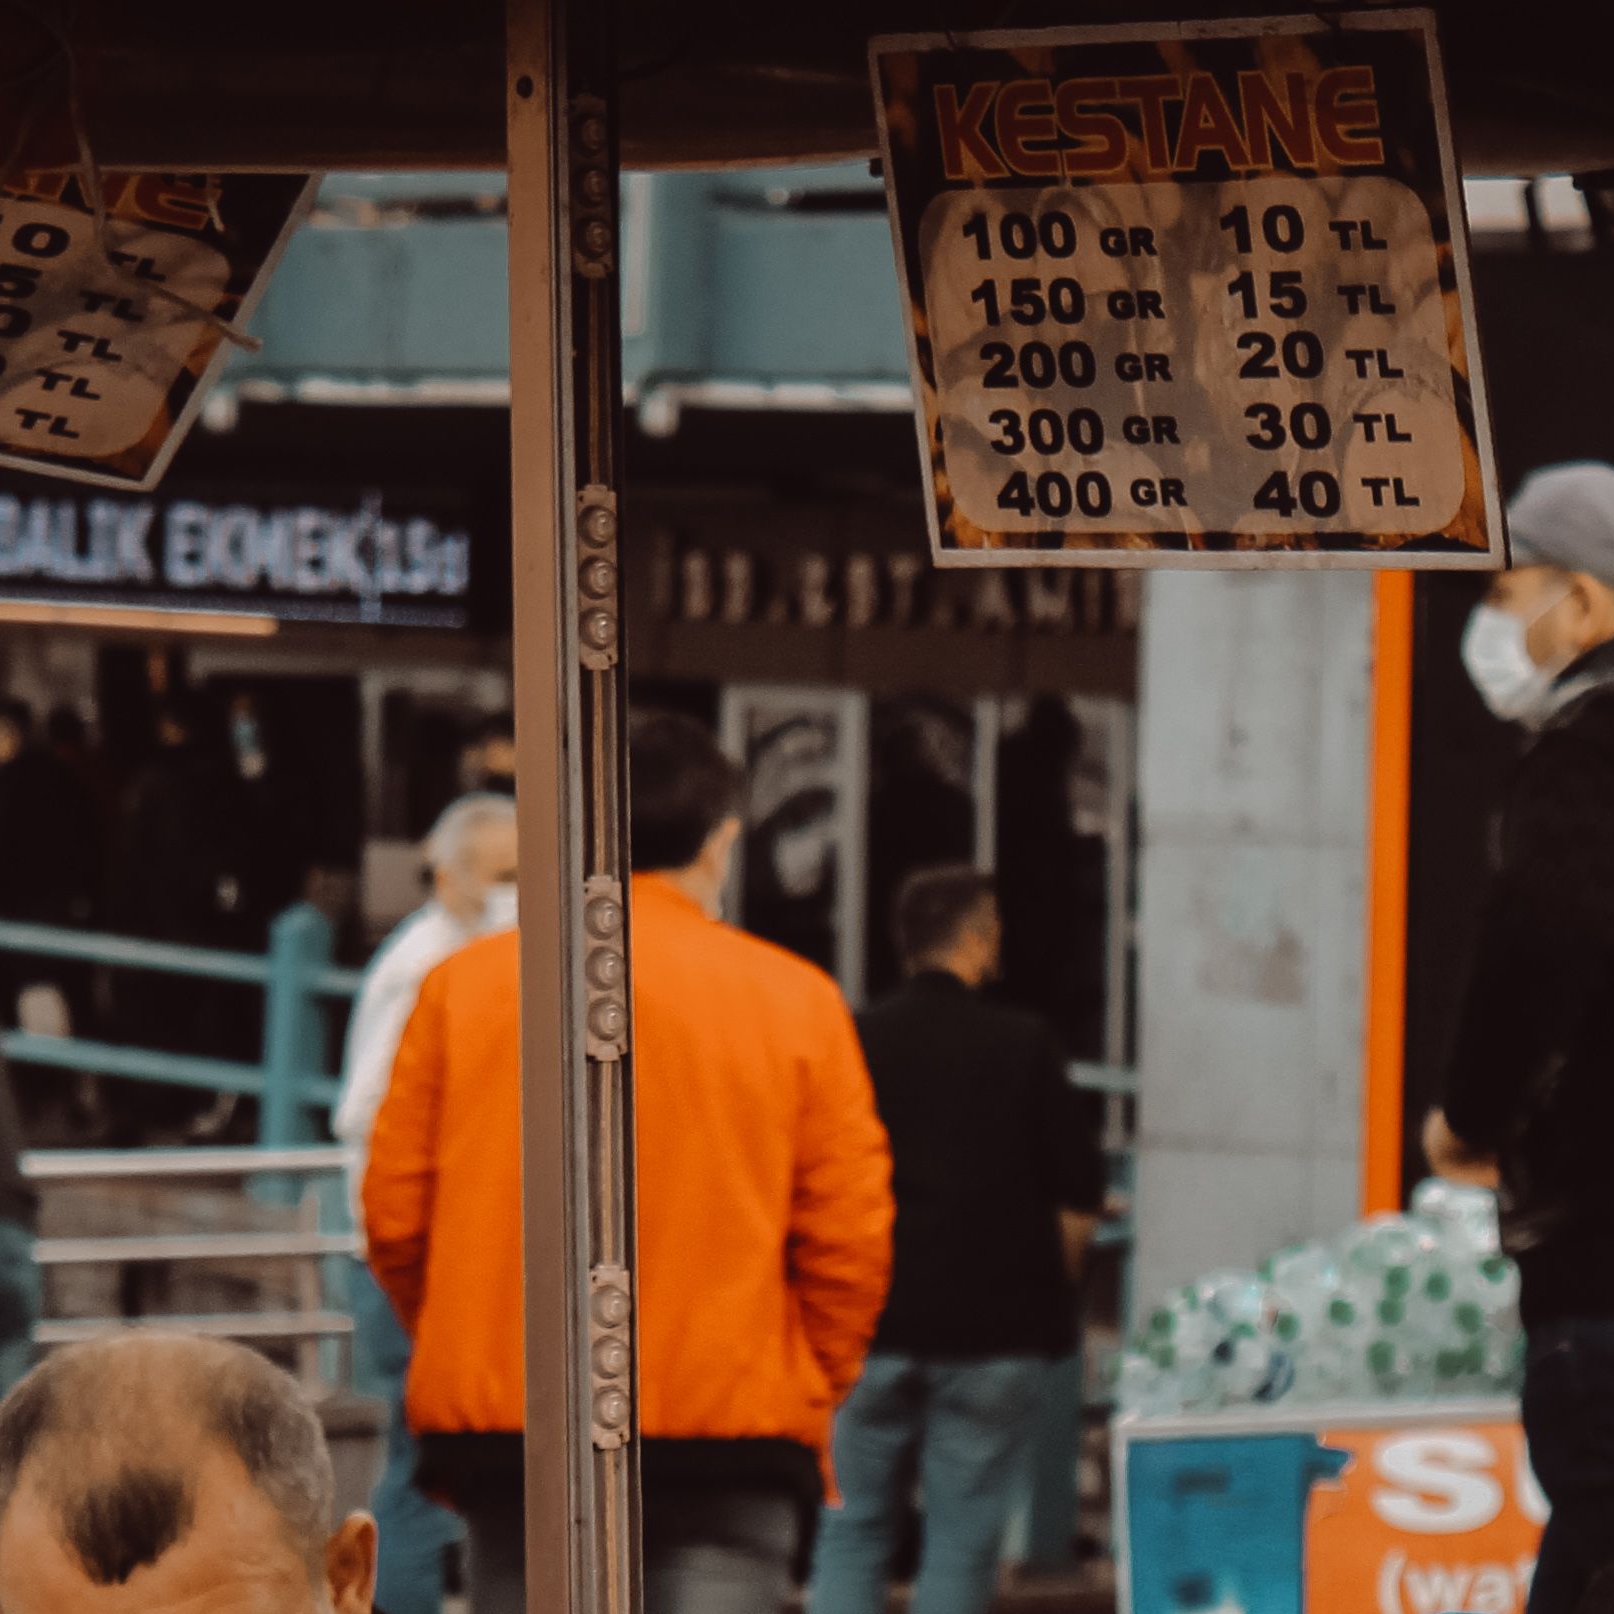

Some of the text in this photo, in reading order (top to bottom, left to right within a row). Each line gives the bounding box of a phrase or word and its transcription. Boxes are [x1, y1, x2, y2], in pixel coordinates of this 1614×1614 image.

[933, 65, 1384, 180] KESTANE
[963, 205, 1387, 260] 100 GR 10 TL
[78, 290, 145, 324] TL
[971, 272, 1395, 325] 150 GR 15 TL
[56, 328, 123, 363] TL
[979, 332, 1404, 388] 200 GR 20 TL
[33, 367, 101, 400] TL
[14, 407, 81, 440] TL
[989, 403, 1412, 455] 300 GR 30 TL
[997, 470, 1420, 518] 400 GR 40 TL
